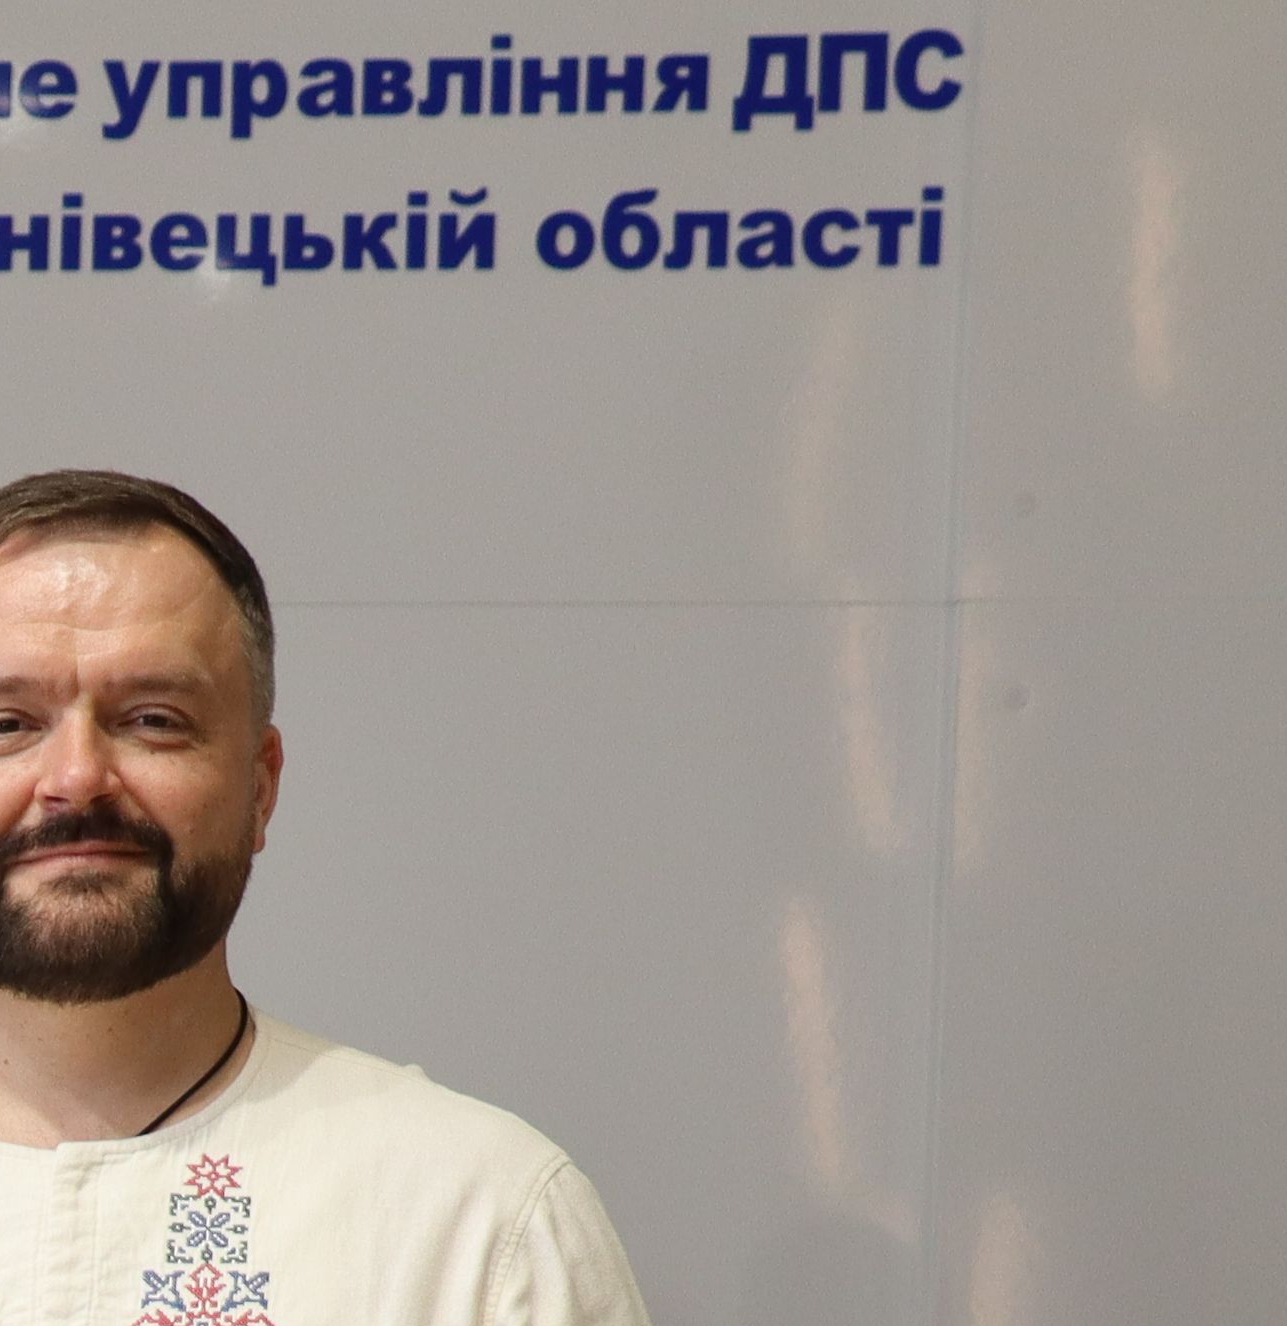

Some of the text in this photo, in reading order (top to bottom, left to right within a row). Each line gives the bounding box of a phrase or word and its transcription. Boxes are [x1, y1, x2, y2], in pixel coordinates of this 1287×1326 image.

[101, 36, 710, 140] управління
[733, 29, 966, 132] ДПС
[534, 188, 945, 274] області
